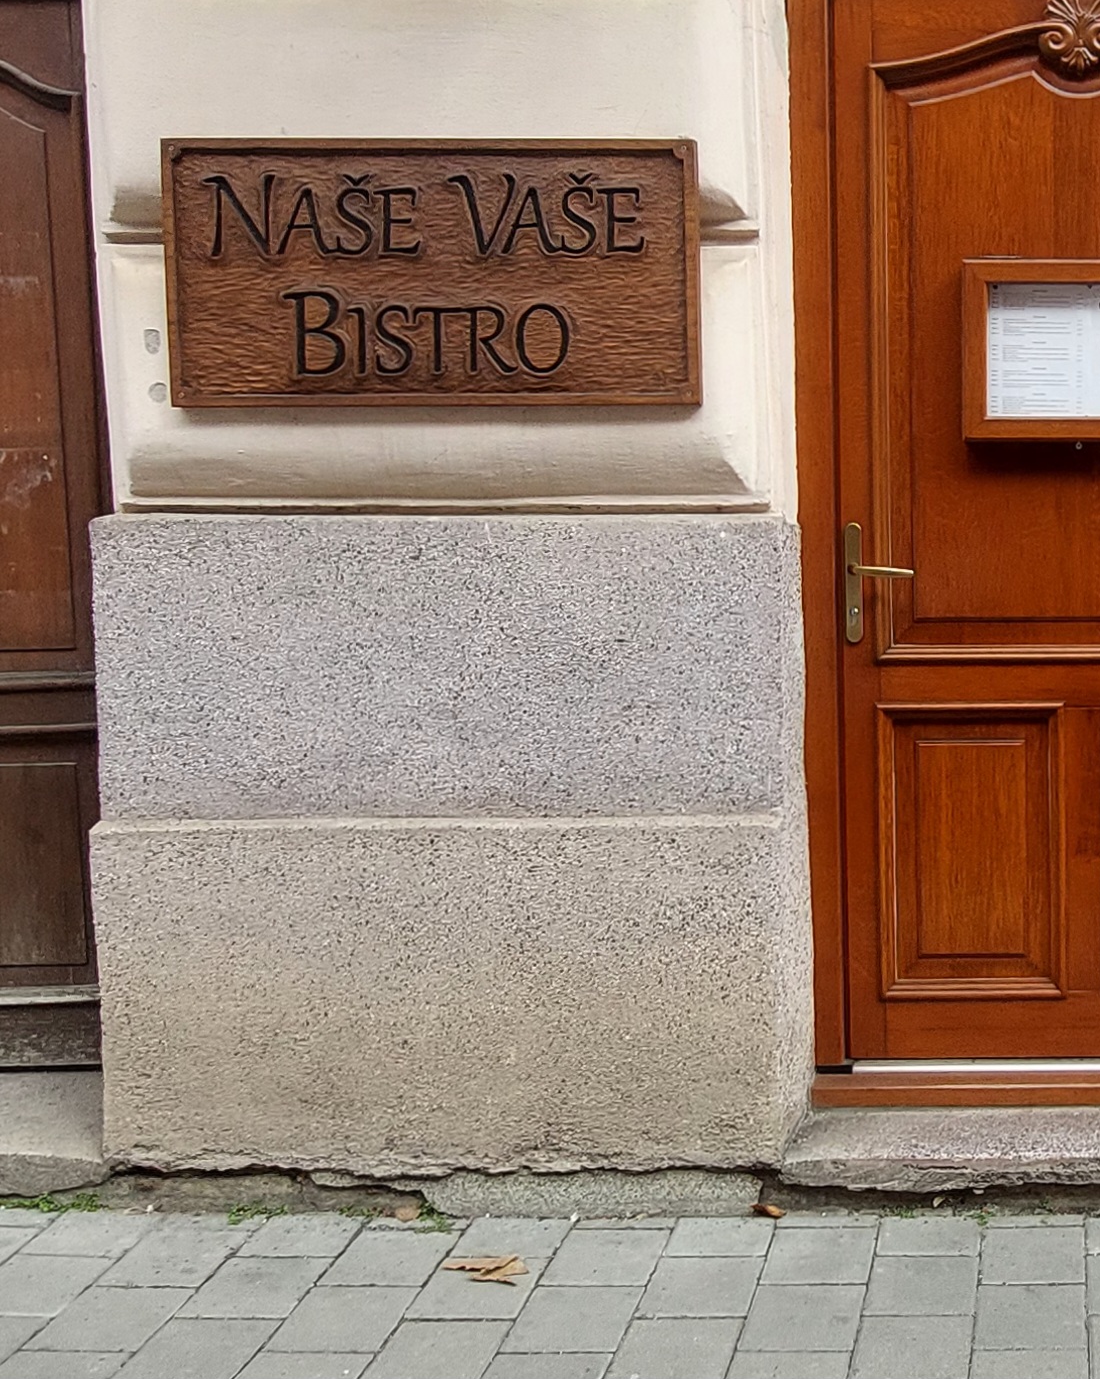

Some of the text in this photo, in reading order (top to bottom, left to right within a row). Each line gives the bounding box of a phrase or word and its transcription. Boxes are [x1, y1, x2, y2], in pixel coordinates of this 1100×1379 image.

[202, 169, 646, 257] NAŠE VAŠE
[283, 287, 571, 377] BISTRO
